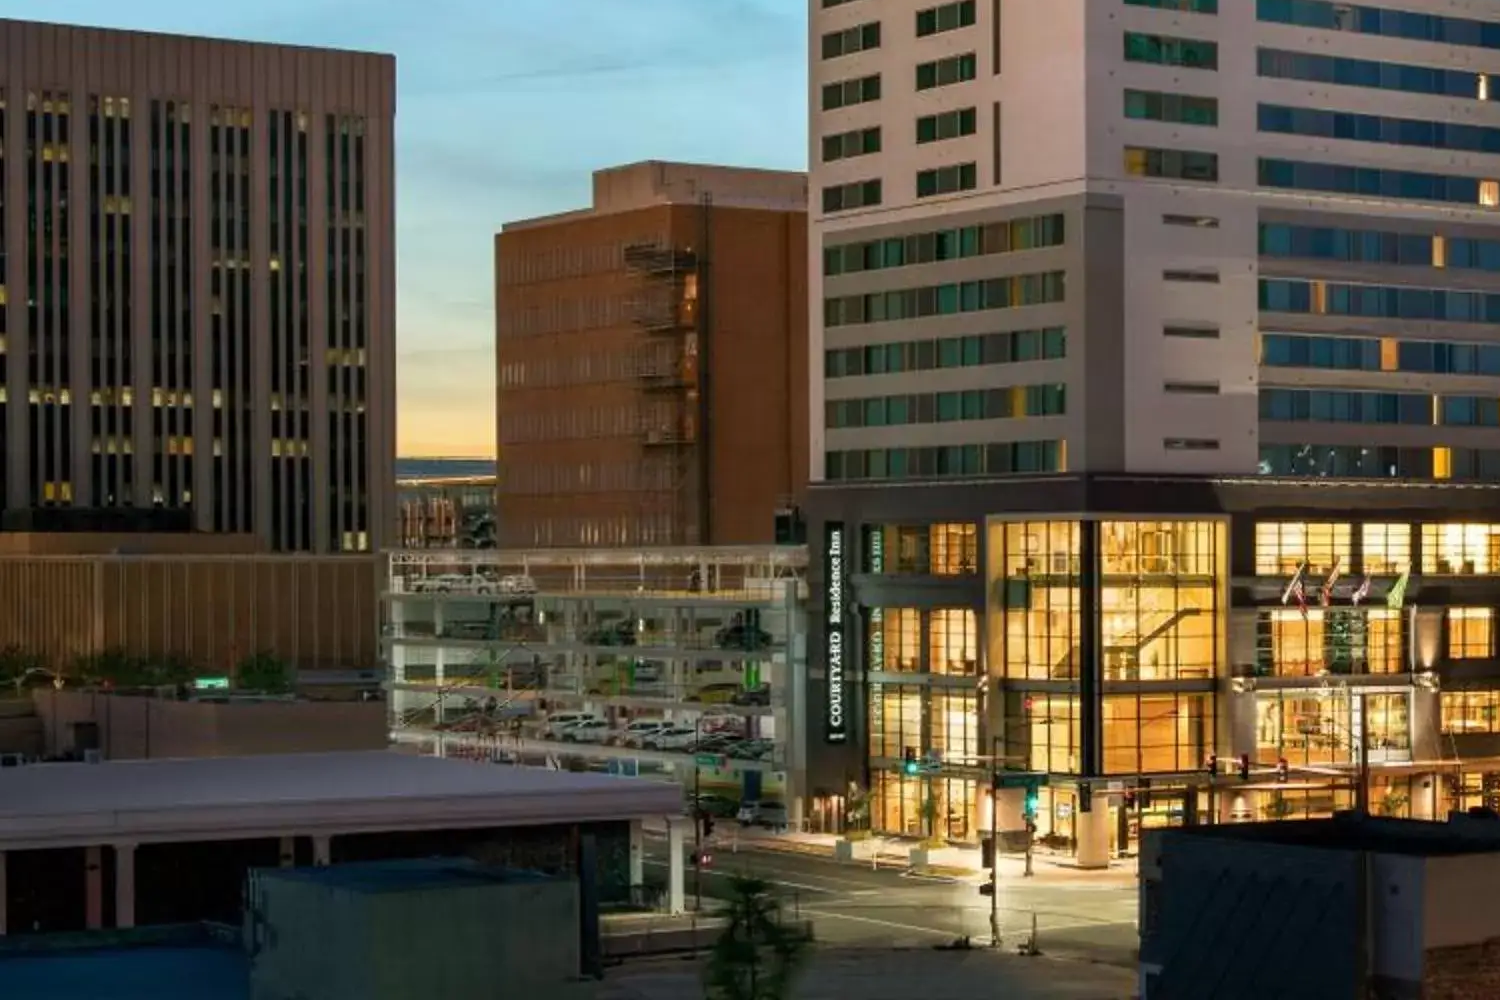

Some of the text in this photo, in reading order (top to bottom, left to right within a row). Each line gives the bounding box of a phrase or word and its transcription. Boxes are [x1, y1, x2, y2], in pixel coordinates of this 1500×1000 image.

[829, 530, 841, 555] Inn
[829, 557, 841, 624] Residence
[829, 631, 842, 726] COURTYARD
